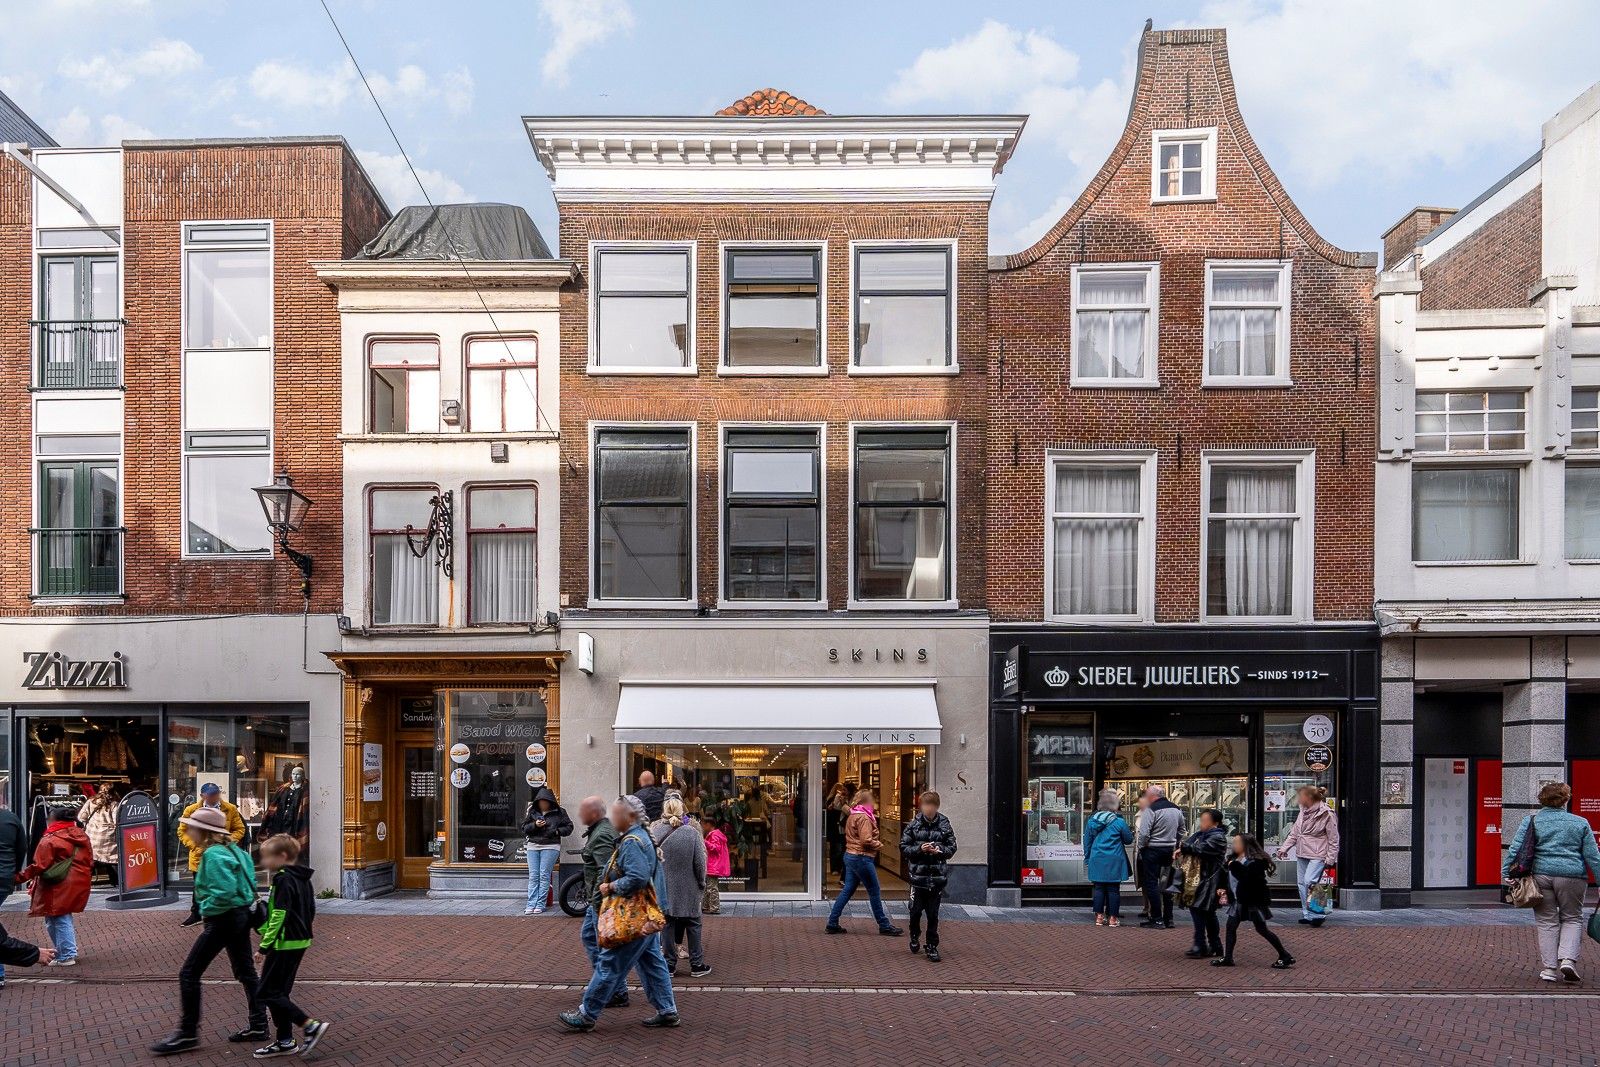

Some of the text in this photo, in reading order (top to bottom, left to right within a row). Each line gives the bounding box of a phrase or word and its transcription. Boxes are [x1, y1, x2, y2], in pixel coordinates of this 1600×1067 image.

[828, 648, 928, 661] SKINS
[21, 650, 128, 689] Zizzi
[1078, 666, 1136, 686] SIEBEL
[1143, 666, 1240, 688] JUWELIERS
[1291, 670, 1318, 679] 1912
[462, 722, 502, 738] Sand
[846, 733, 916, 742] SKINS
[1160, 749, 1193, 761] Diamonds
[126, 803, 151, 817] Zizzi
[130, 831, 149, 841] SALE
[128, 851, 153, 868] 50%
